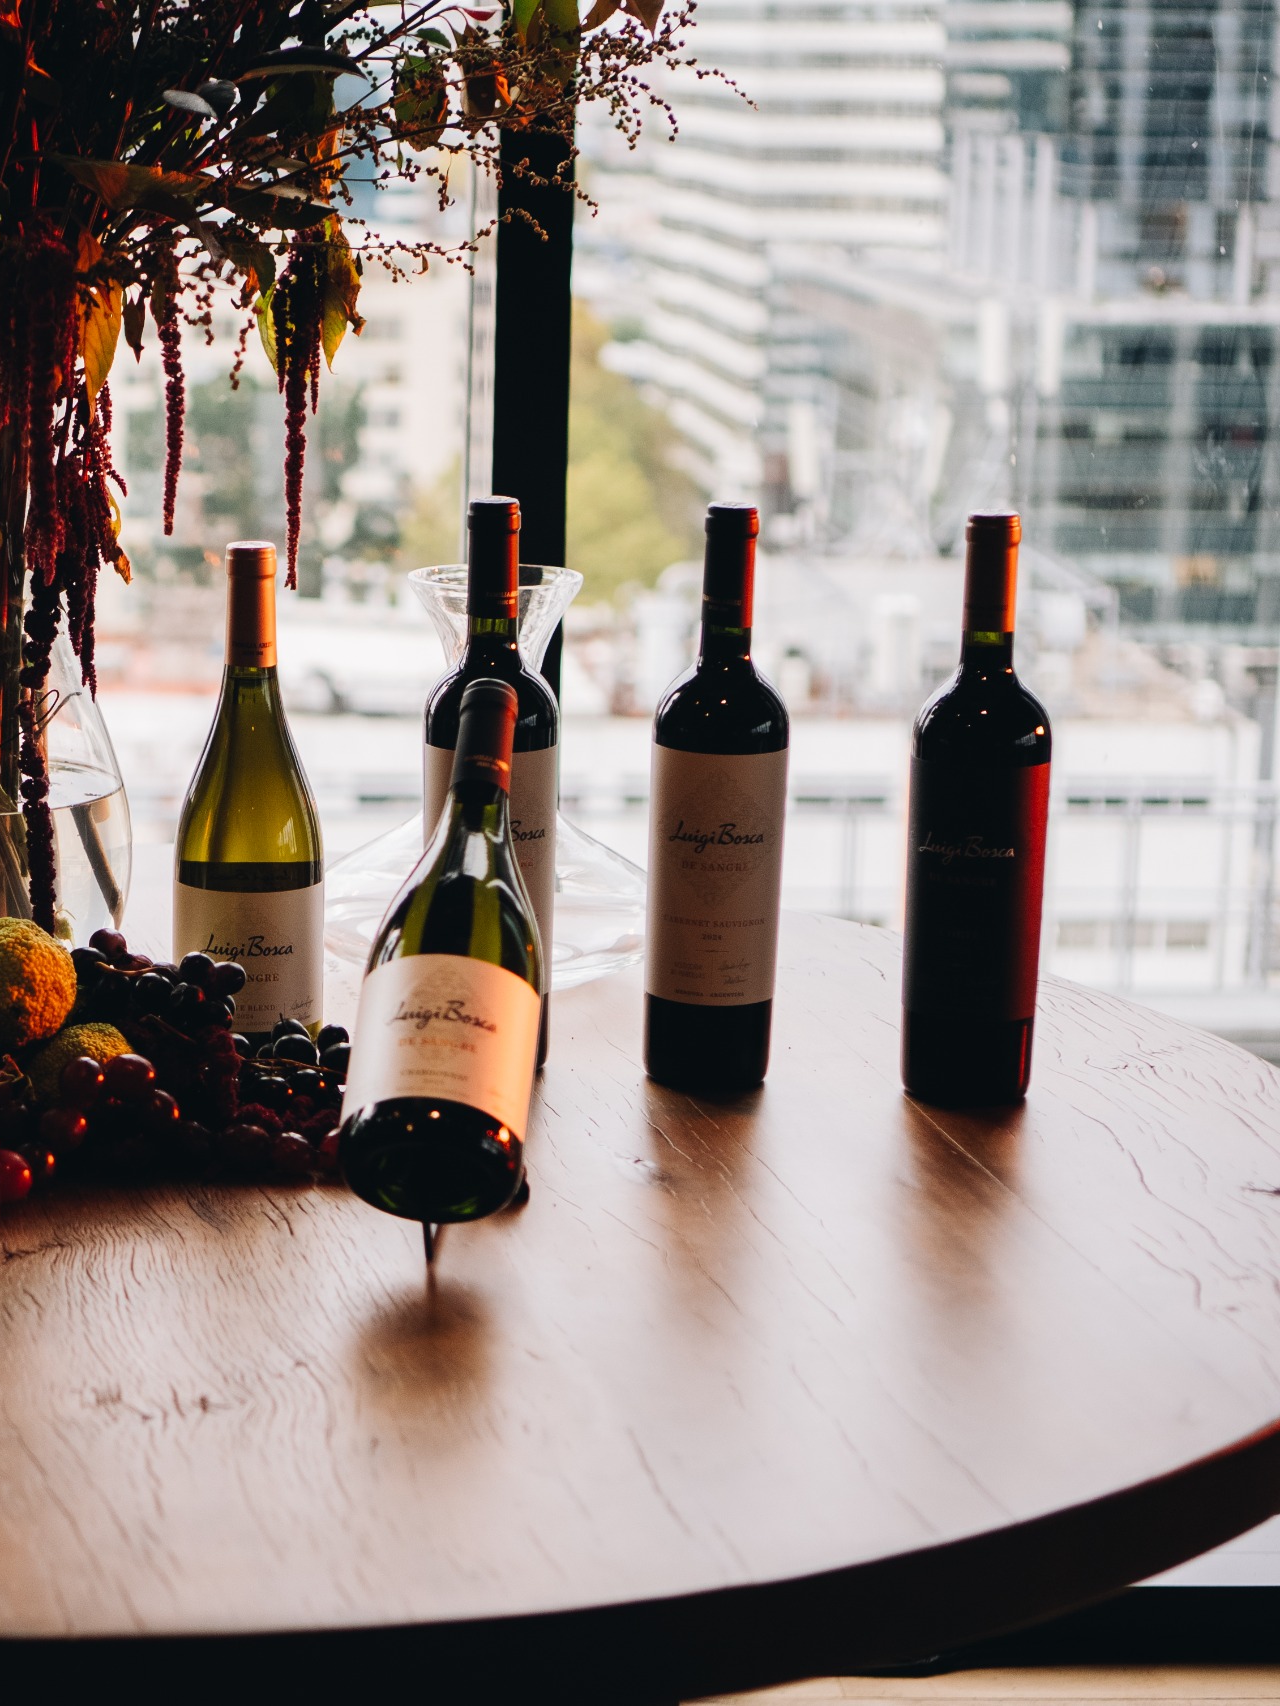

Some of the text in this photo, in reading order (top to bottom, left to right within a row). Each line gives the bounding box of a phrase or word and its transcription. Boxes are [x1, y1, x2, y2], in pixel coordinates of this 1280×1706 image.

[668, 820, 764, 854] Luigi Bosca
[918, 831, 1016, 865] Luigi Bosca
[681, 860, 749, 872] DE SANGRE
[663, 914, 766, 929] CABERNET SAUVIGNON
[200, 933, 295, 961] Luigi Bosca
[246, 974, 280, 983] NGRE
[386, 1000, 497, 1033] Luigi Bosca
